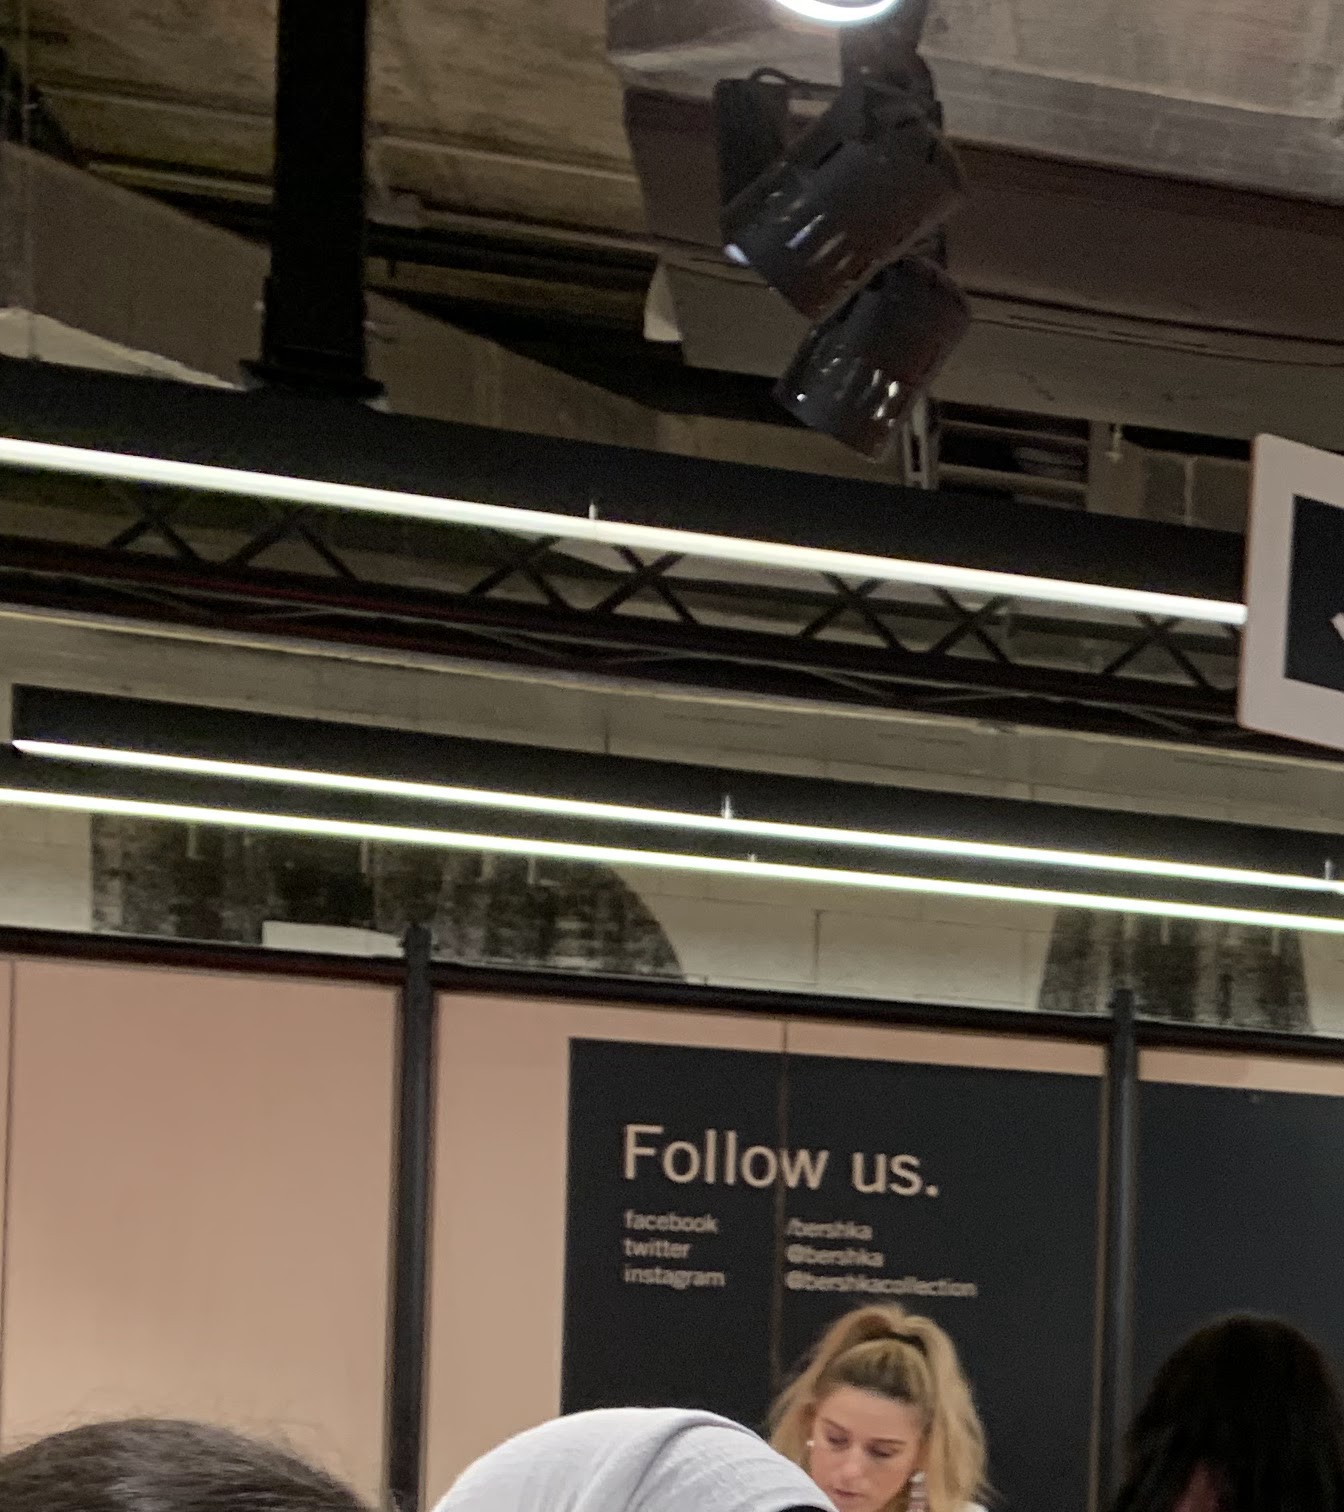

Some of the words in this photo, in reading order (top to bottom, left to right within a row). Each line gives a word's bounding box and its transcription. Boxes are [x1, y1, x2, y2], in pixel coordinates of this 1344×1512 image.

[624, 1123, 829, 1190] Follow
[852, 1151, 940, 1198] us.
[623, 1209, 720, 1235] facebook
[623, 1238, 692, 1260] twitter
[623, 1263, 727, 1290] instagram
